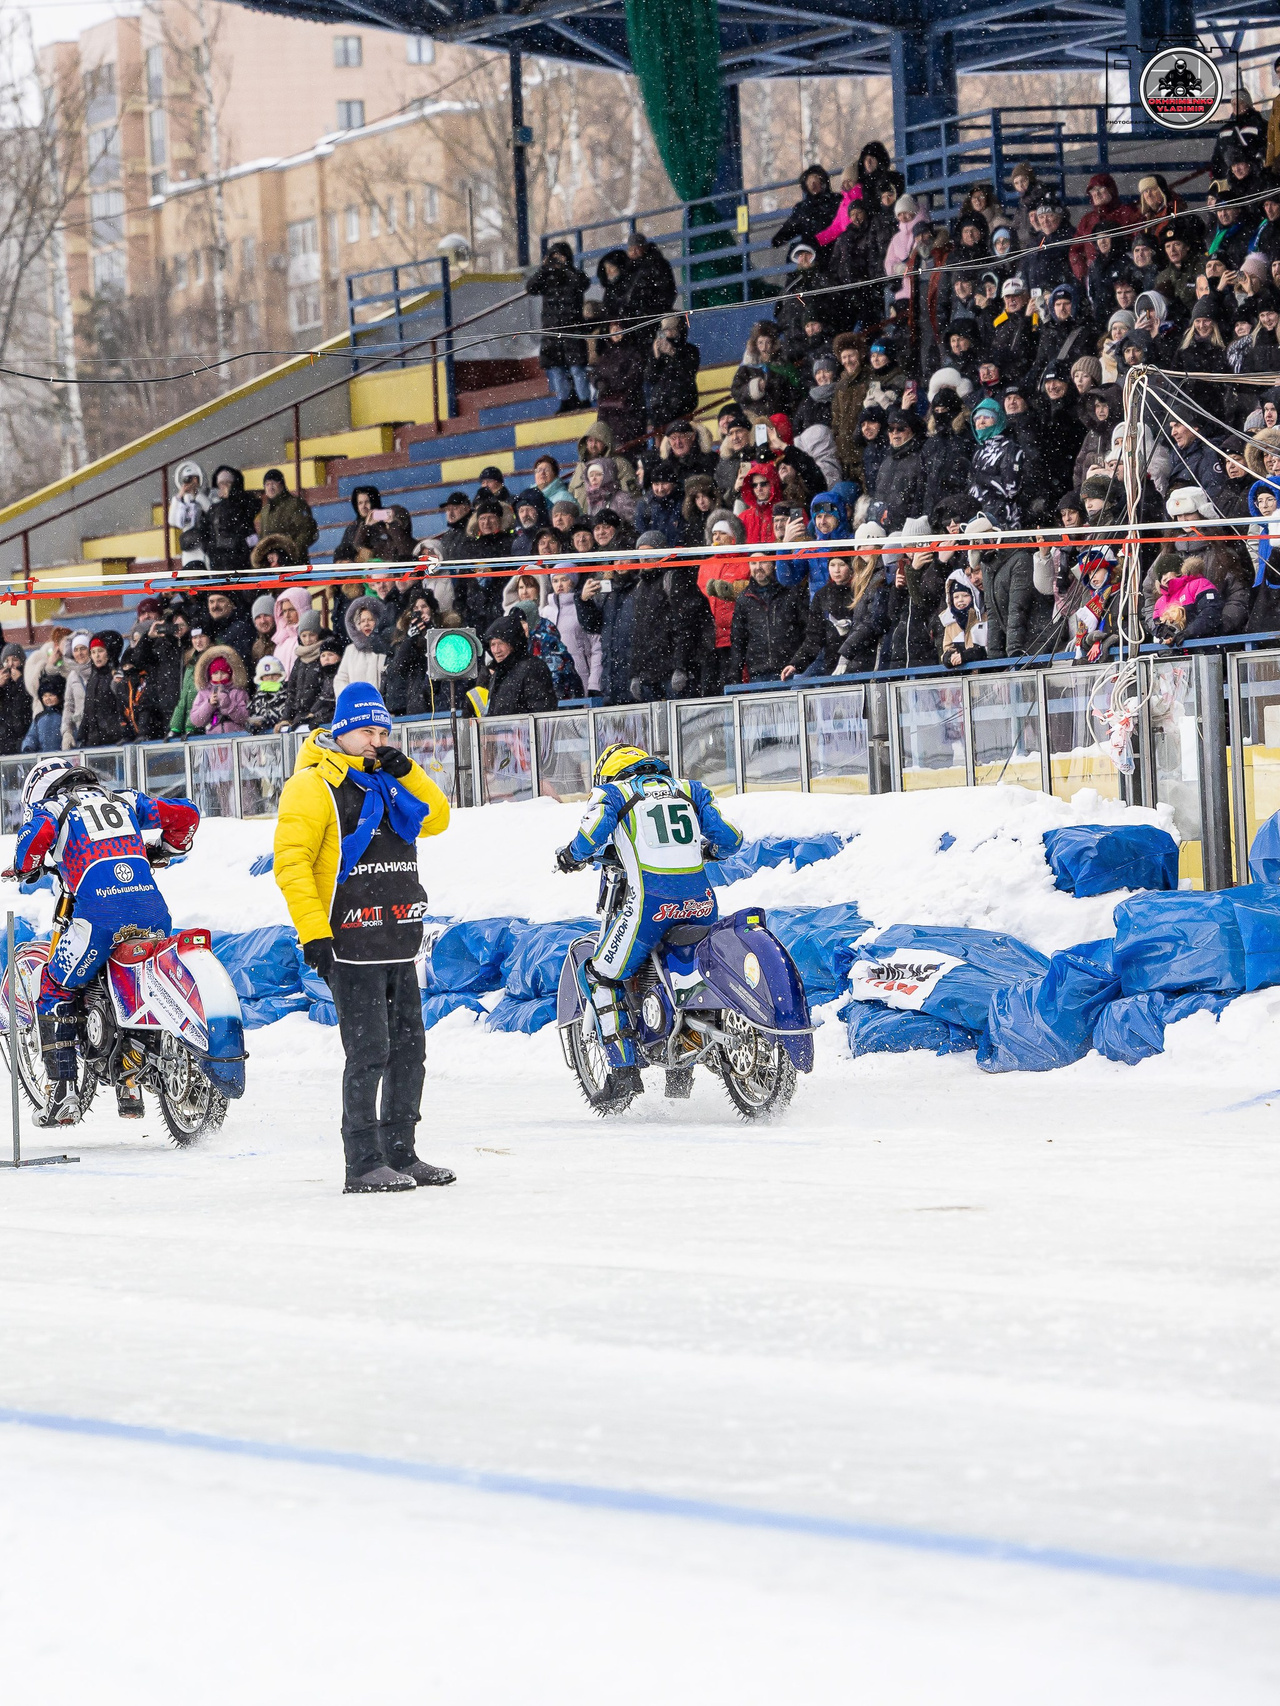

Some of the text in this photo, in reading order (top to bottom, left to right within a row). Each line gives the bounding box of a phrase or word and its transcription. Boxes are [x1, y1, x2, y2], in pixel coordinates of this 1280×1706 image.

[83, 802, 124, 832] 16
[647, 804, 694, 845] 15
[349, 861, 417, 876] ОРГАНИЗАТ
